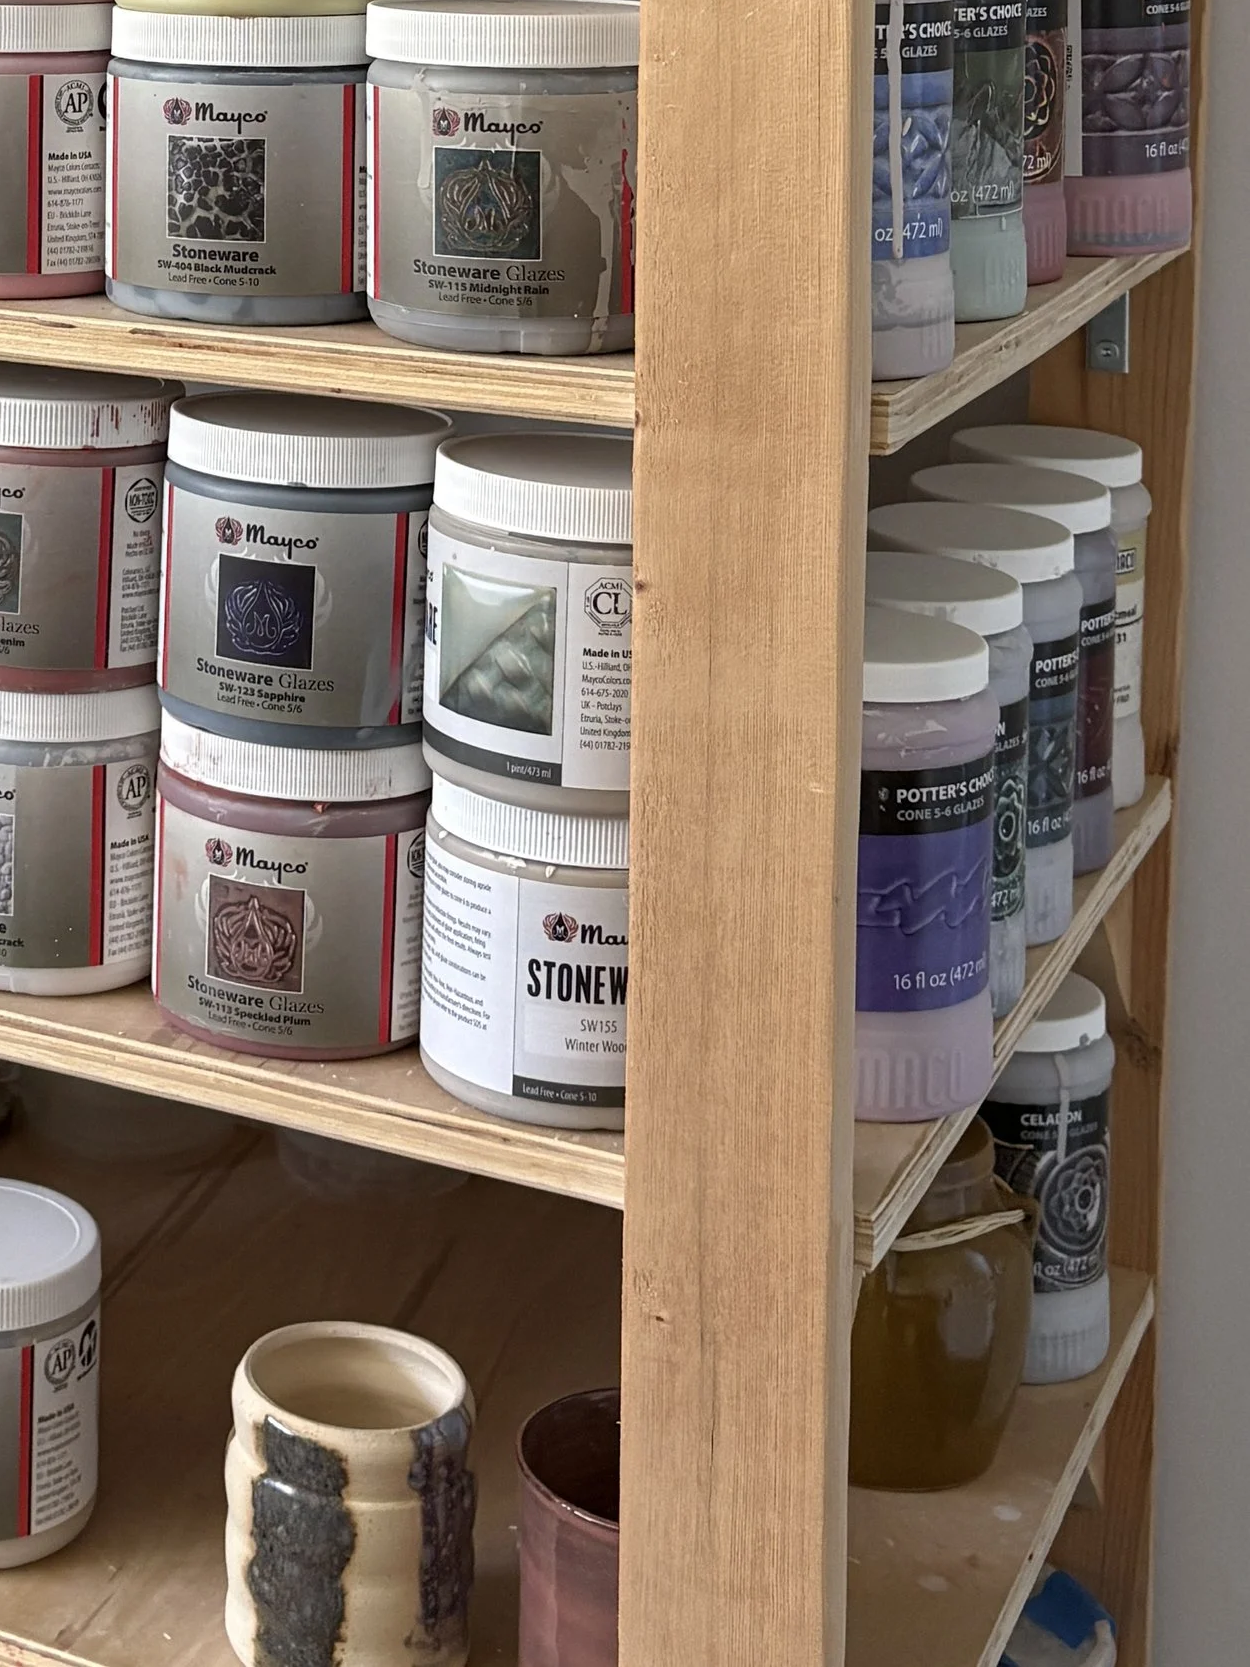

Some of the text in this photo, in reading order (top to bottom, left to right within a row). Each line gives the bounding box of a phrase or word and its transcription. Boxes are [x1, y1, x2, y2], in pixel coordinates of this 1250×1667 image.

[988, 1, 1022, 20] CHOICE
[918, 19, 952, 40] CHOICE
[902, 43, 938, 59] GLAZES
[65, 94, 88, 113] AP
[195, 102, 268, 134] Mayco
[463, 111, 544, 146] Mayco
[48, 152, 68, 161] Made
[79, 151, 92, 160] USA
[172, 244, 259, 262] Stoneware
[157, 259, 277, 275] SW-404 Black Mudcrack
[413, 259, 566, 281] Stoneware Glazes
[428, 279, 550, 296] SW-115 Midnight Rain
[246, 523, 320, 559] Mayco
[592, 592, 629, 615] CL
[196, 657, 335, 693] Stoneware Glazes
[218, 681, 306, 704] SW-123 Sapphire
[260, 700, 285, 712] Cone
[286, 702, 303, 713] 5/6
[125, 776, 146, 799] AP
[1027, 820, 1040, 835] 16
[236, 846, 308, 883] Mayco
[187, 975, 324, 1015] Stoneware Glazes
[580, 1019, 617, 1033] SW155
[53, 1350, 71, 1373] AP
